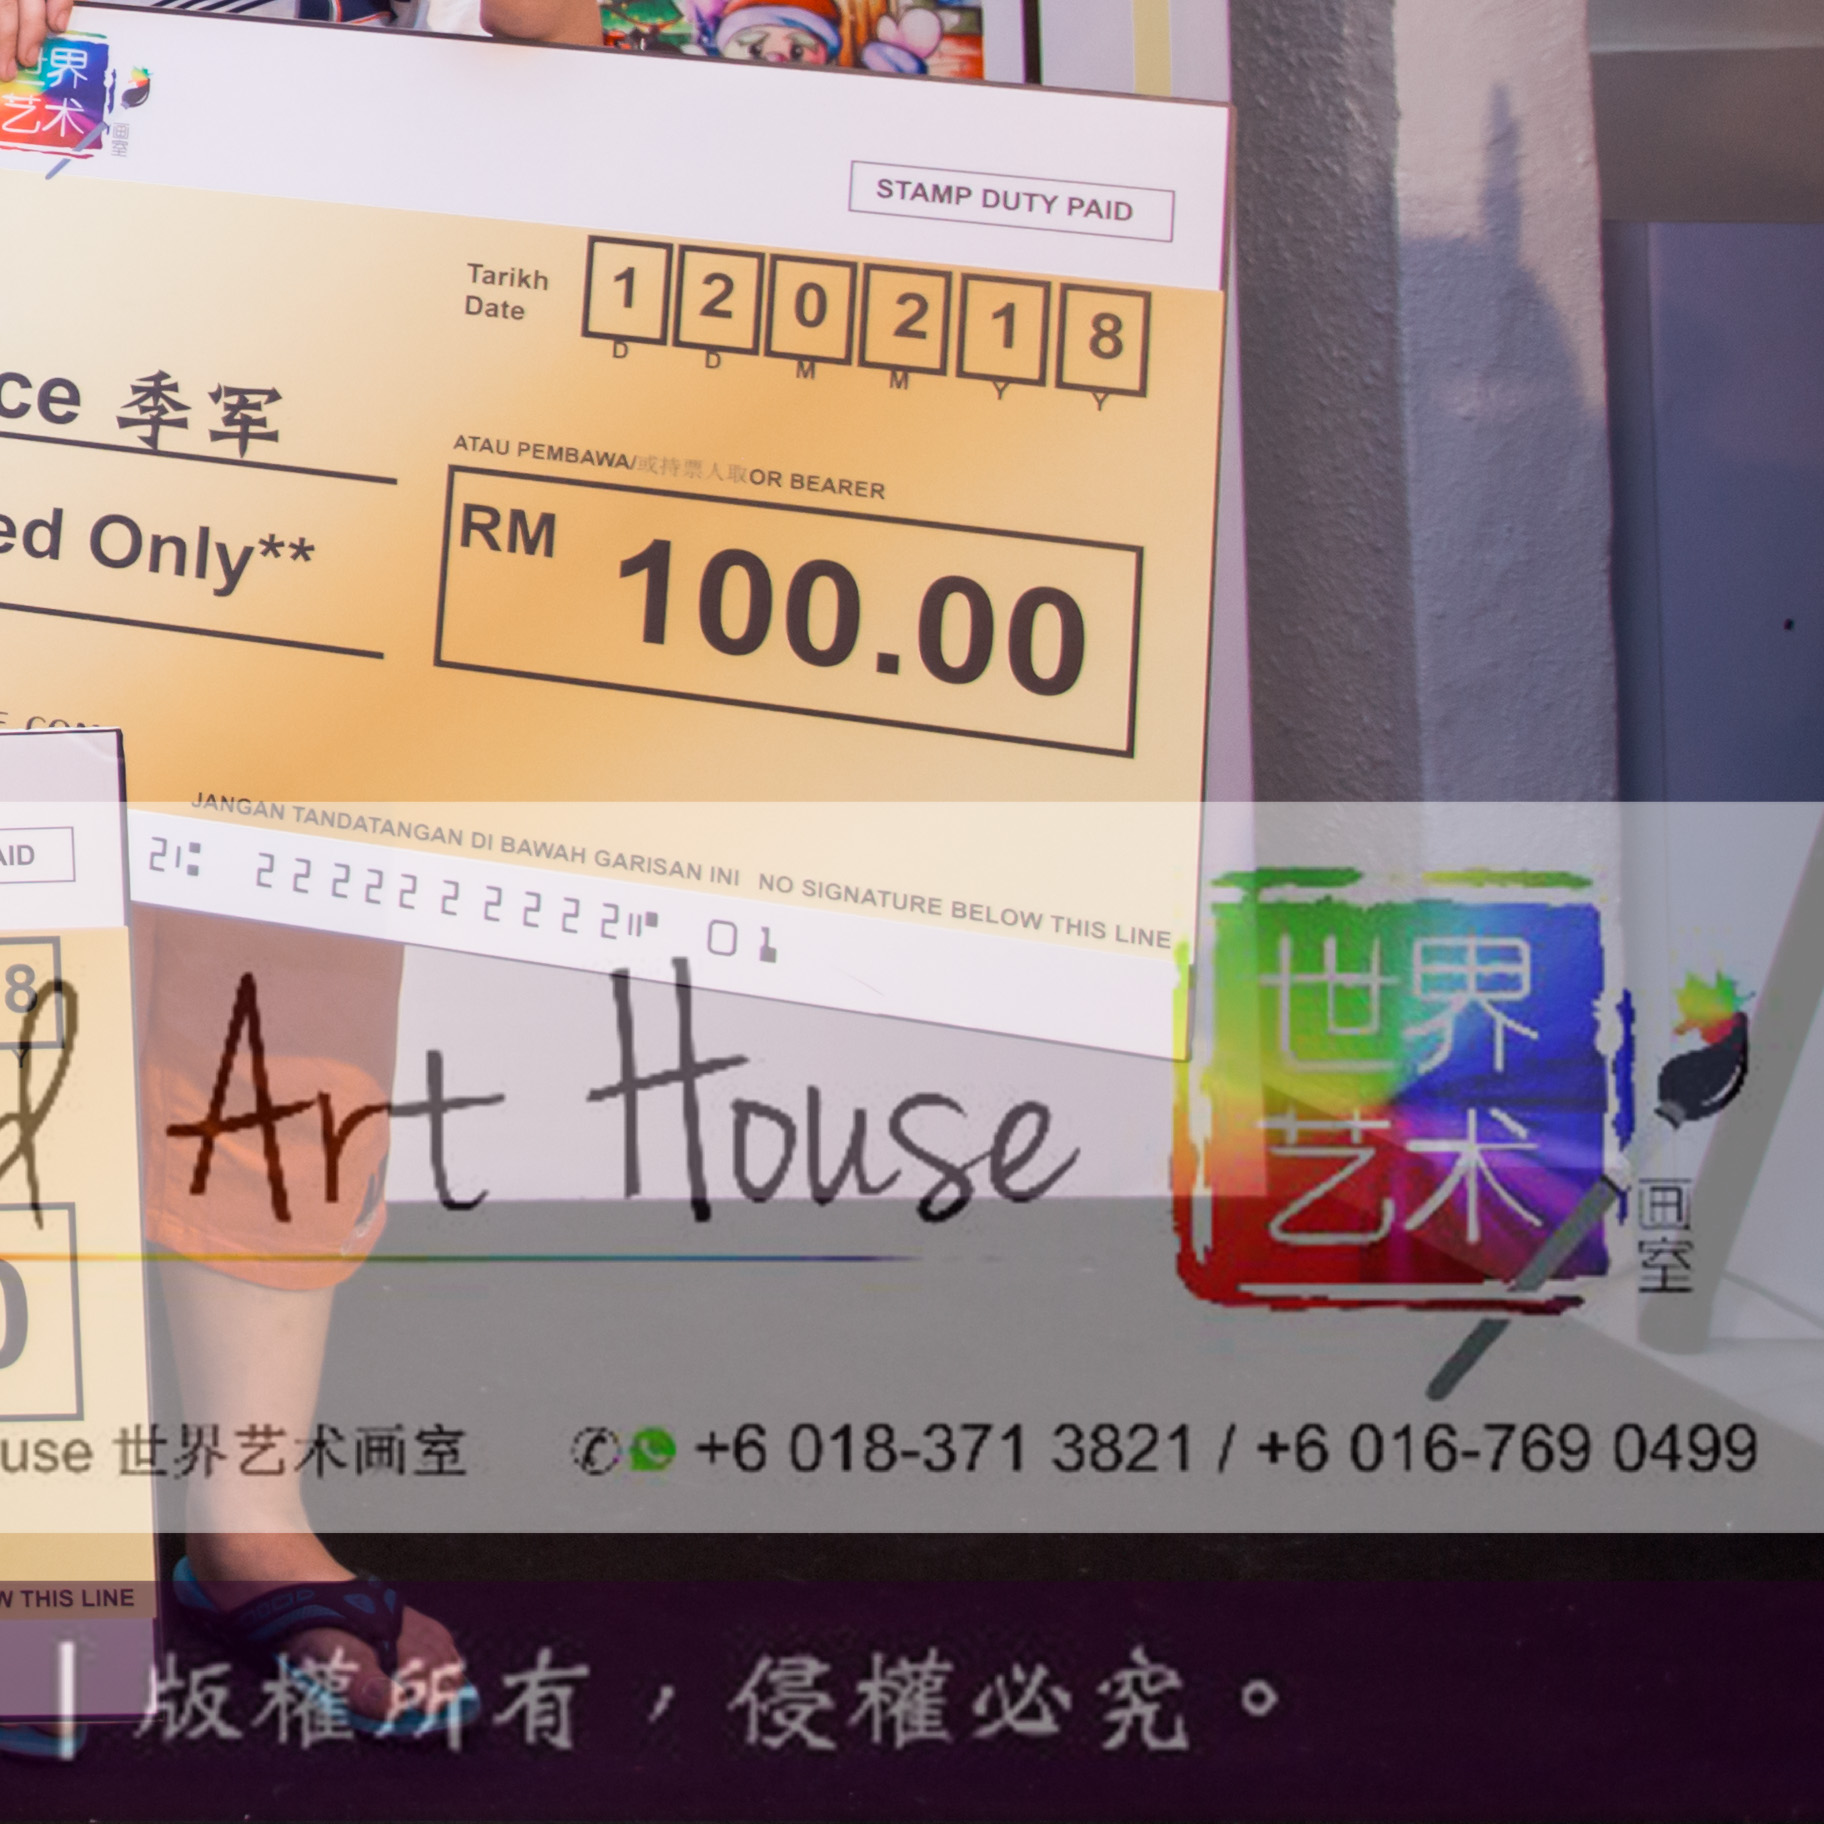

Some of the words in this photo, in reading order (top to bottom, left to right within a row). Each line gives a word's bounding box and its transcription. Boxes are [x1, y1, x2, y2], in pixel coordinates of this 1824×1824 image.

[2, 96, 85, 137] 艺术
[876, 177, 973, 209] STAMP
[981, 187, 1058, 219] DUTY
[1066, 195, 1134, 223] PAID
[467, 262, 550, 294] Tarikh
[464, 295, 525, 322] Date
[116, 369, 283, 458] 季军
[453, 434, 511, 455] ATAU
[790, 472, 886, 500] BEARER
[459, 503, 556, 558] RM
[618, 539, 1085, 697] 100.00
[191, 792, 285, 820] JANGAN
[292, 806, 463, 846] TANDATANGAN
[471, 831, 492, 850] DI
[500, 836, 586, 864] BAWAH
[594, 849, 702, 880] GARISAN
[710, 866, 740, 886] INI
[759, 873, 794, 894] NO
[802, 879, 943, 916] SIGNATURE
[951, 901, 1043, 931] BELOW
[1050, 915, 1106, 940] THIS
[1115, 925, 1172, 949] LINE
[19, 1589, 73, 1609] THIS
[81, 1588, 134, 1608] LINE
